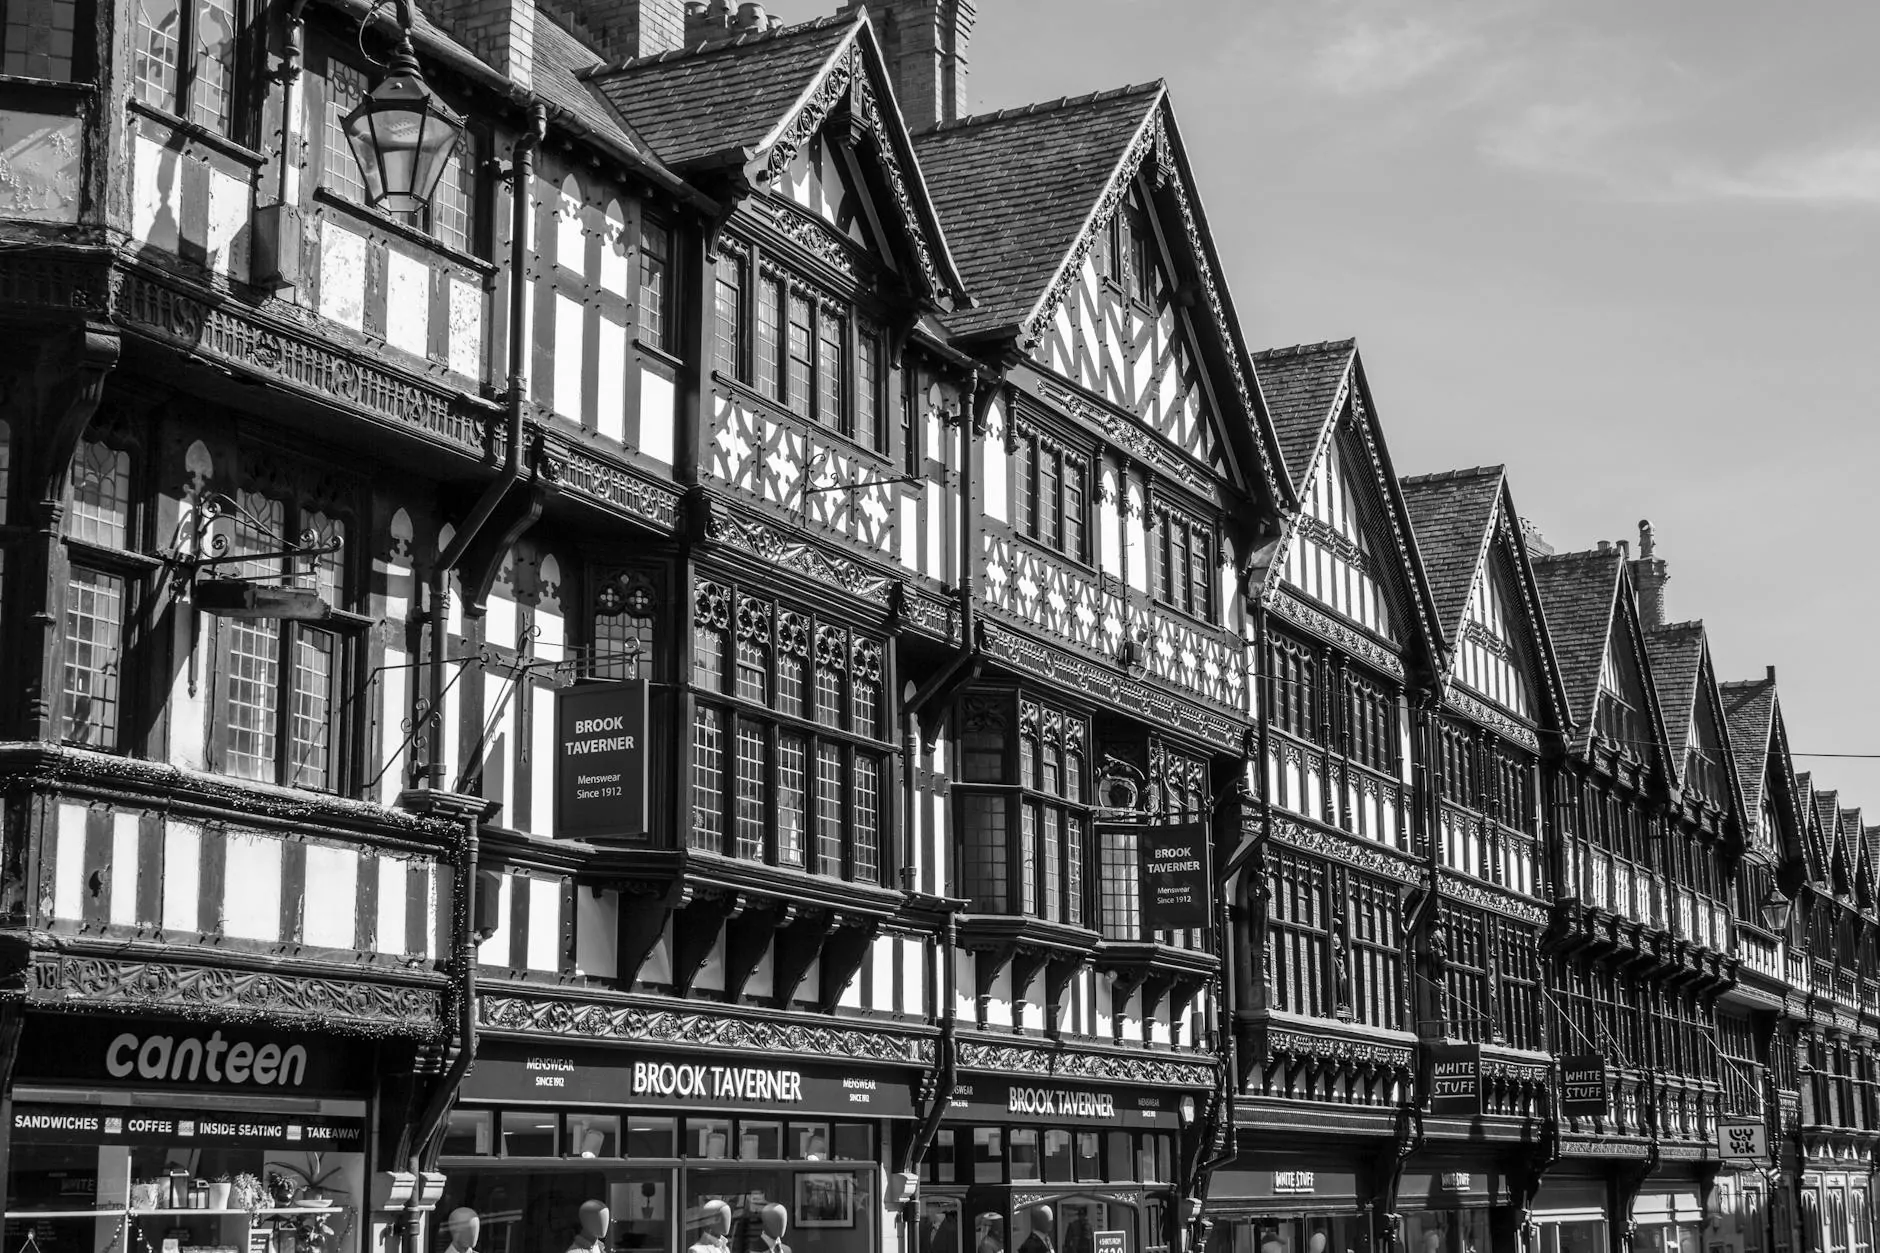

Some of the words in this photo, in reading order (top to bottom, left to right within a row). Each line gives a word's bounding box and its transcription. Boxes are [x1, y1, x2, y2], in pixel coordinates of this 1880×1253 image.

[575, 716, 624, 734] BROOK
[565, 736, 634, 755] TAVERNER
[577, 773, 621, 785] Menswear
[577, 788, 599, 799] Since
[601, 786, 622, 797] 1912
[1155, 847, 1191, 859] BROOK
[1147, 861, 1200, 873] TAVERNER
[1176, 895, 1191, 903] 1912
[106, 1030, 307, 1086] canteen
[526, 1057, 575, 1071] MENSWEAR
[1434, 1062, 1475, 1075] WHITE
[535, 1076, 553, 1087] SINCE
[632, 1061, 707, 1096] BROOK
[711, 1066, 802, 1100] TAVERNER
[1565, 1070, 1601, 1082] WHITE
[1434, 1081, 1475, 1095] STUFF
[1565, 1087, 1602, 1099] STUFF
[1009, 1086, 1054, 1113] BROOK
[1056, 1090, 1115, 1117] TAVERNER
[15, 1115, 99, 1130] SANDWICHES
[128, 1120, 172, 1133] COFFEE
[200, 1122, 236, 1135] INSIDE
[238, 1124, 282, 1137] SEATING
[307, 1126, 360, 1140] TAKEAWAY
